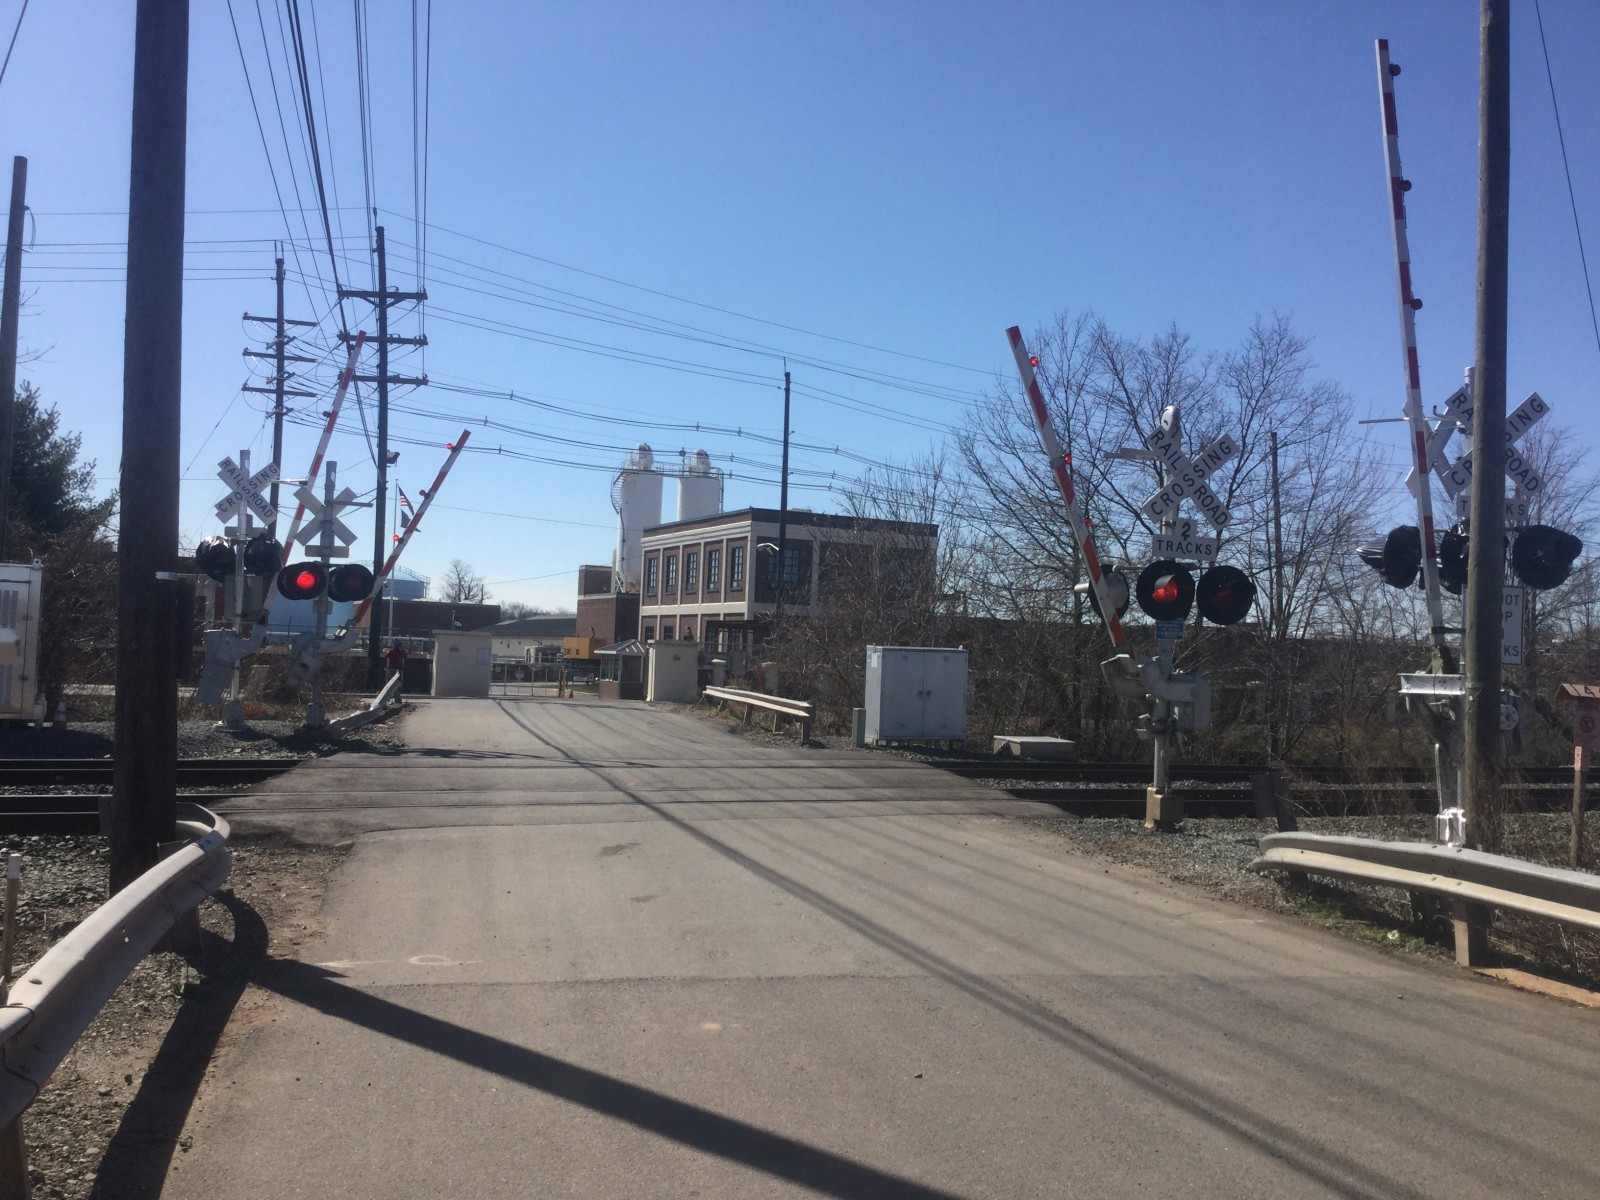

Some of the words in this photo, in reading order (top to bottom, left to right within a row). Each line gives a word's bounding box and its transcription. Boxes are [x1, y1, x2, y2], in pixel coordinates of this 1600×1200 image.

[1451, 393, 1474, 422] RA
[218, 465, 278, 513] CROSSING
[221, 459, 244, 487] RAIL
[249, 492, 274, 518] ROAD
[1150, 441, 1232, 516] CROSSING
[1151, 430, 1181, 471] RAIL
[1193, 485, 1228, 526] ROAD
[1461, 500, 1525, 516] TKS
[1181, 521, 1191, 537] 2
[1157, 539, 1212, 556] TRACKS
[1505, 594, 1520, 607] OT
